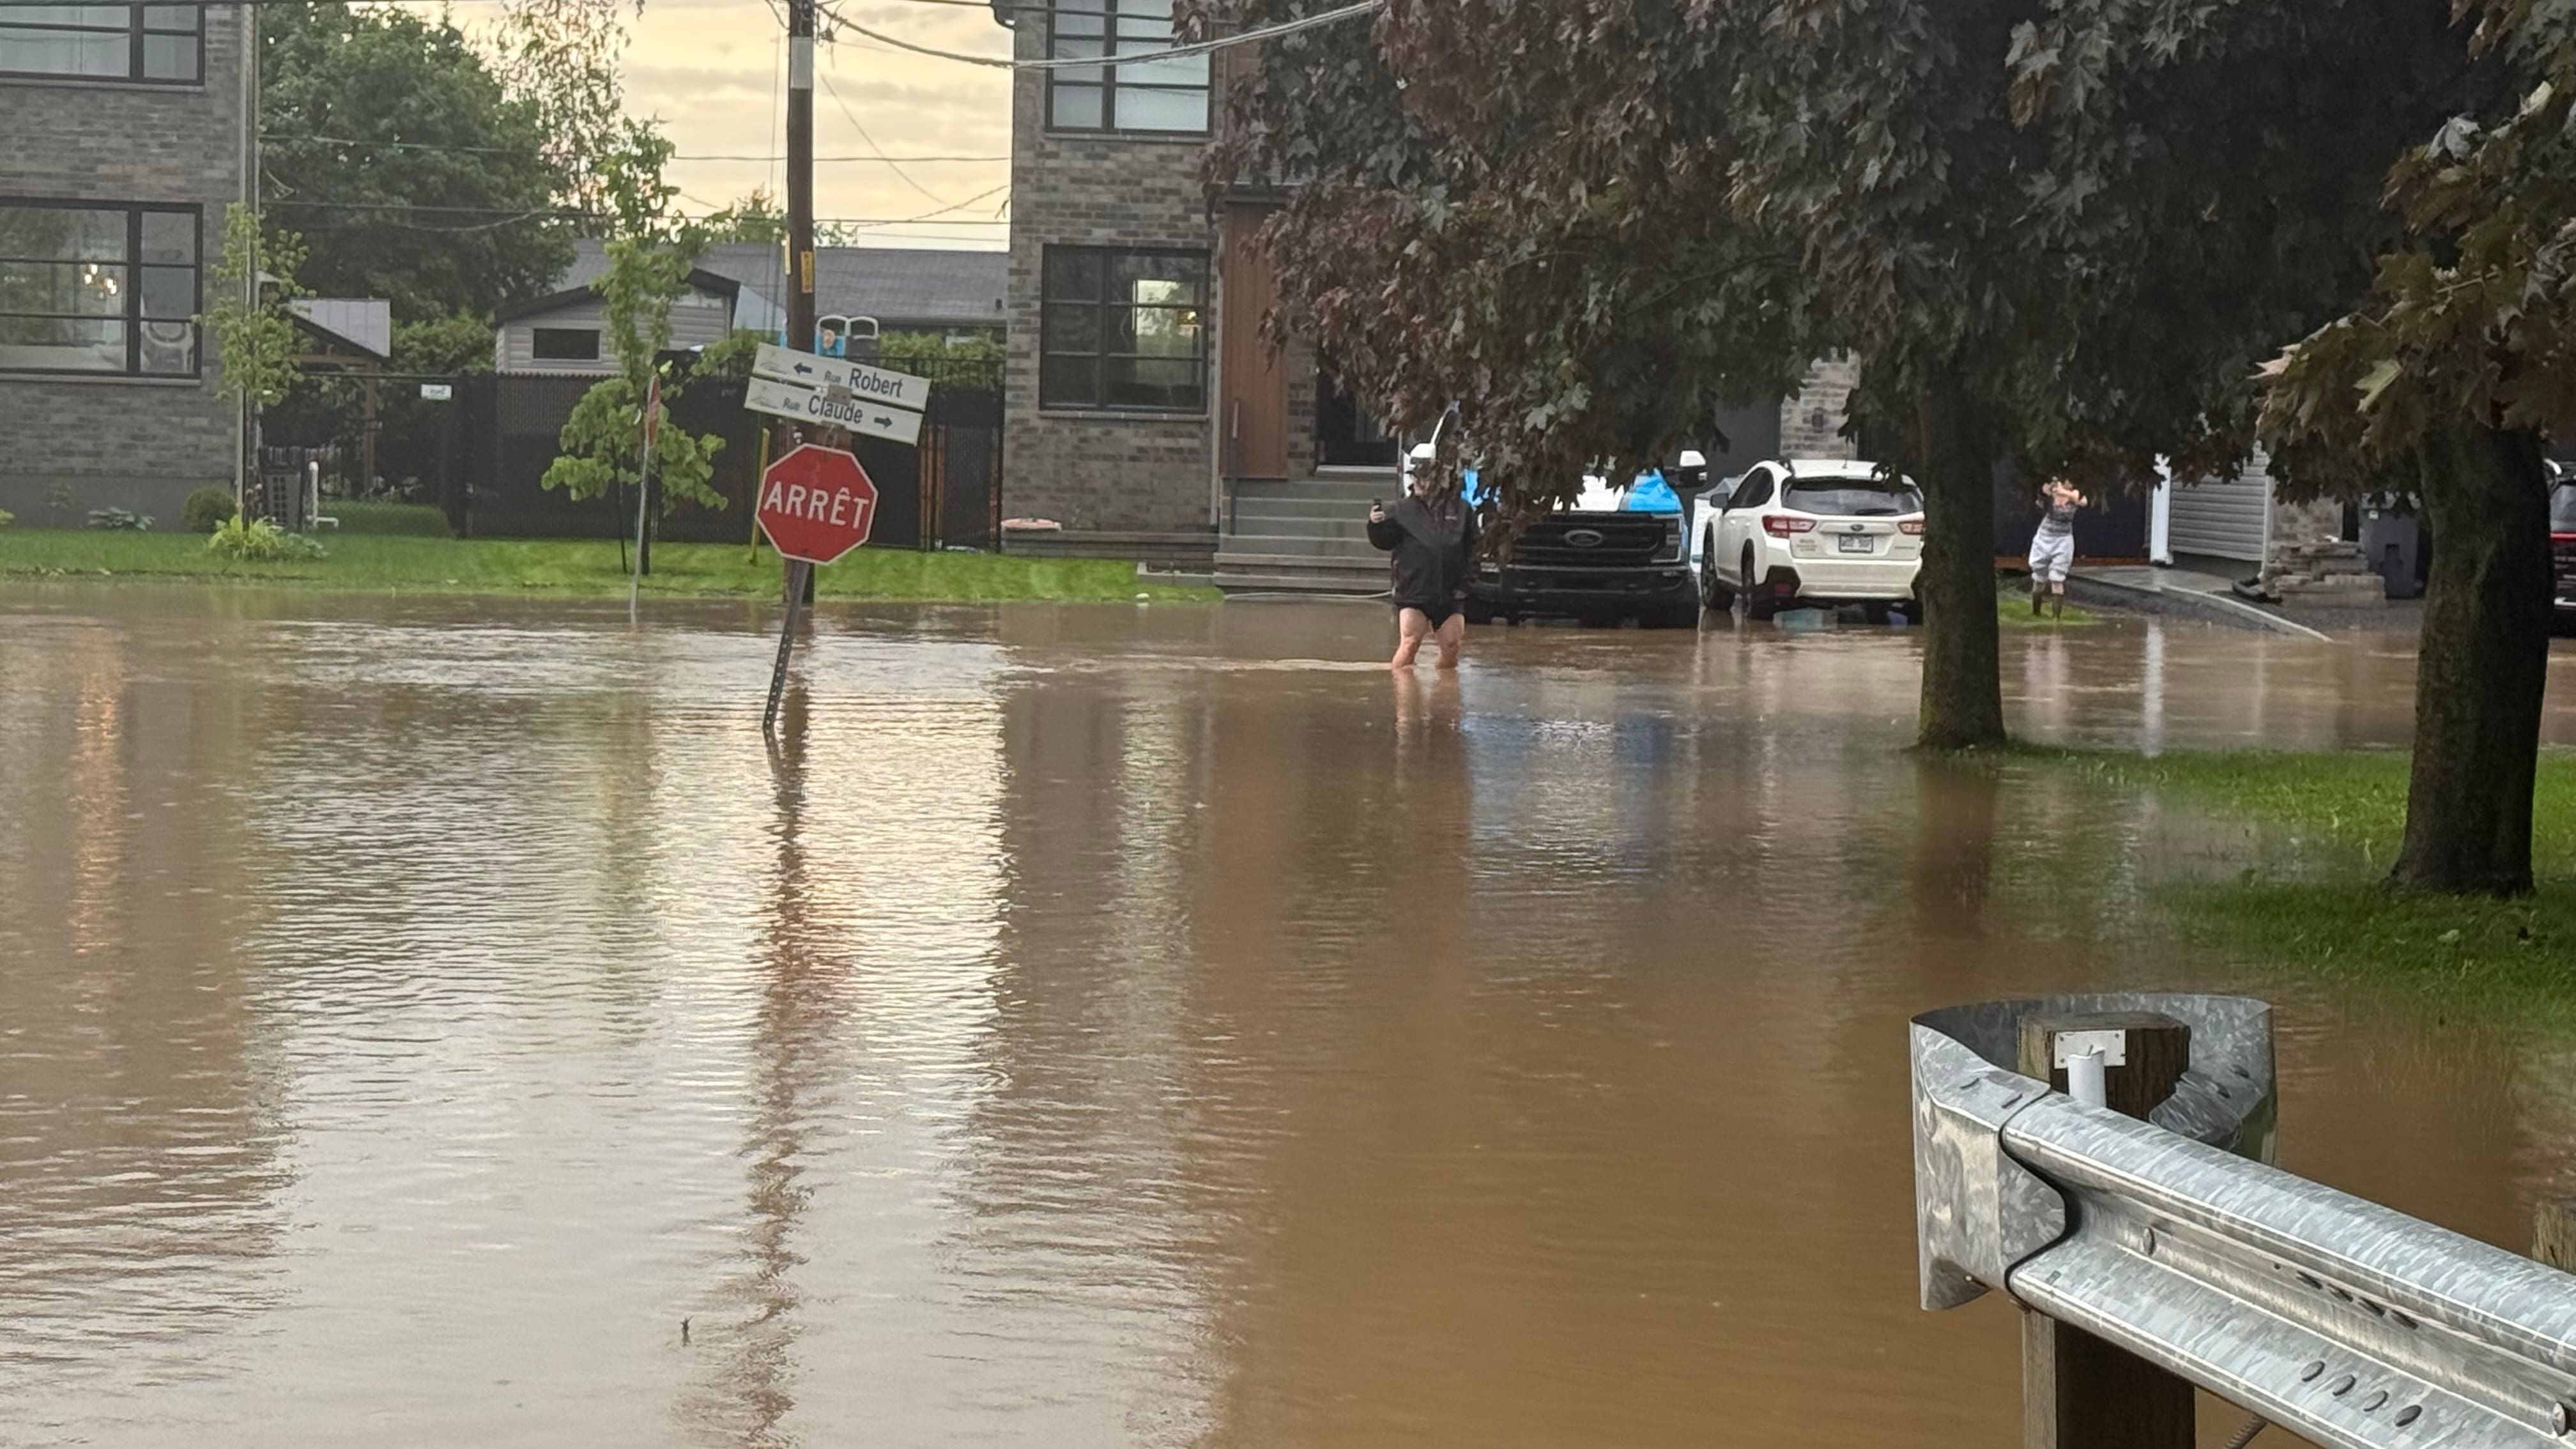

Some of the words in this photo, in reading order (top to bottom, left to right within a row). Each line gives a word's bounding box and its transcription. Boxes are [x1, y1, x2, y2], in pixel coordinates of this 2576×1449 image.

[824, 369, 841, 383] Rue
[849, 367, 903, 398] Robert
[783, 397, 801, 411] Rue
[808, 395, 863, 424] Claude
[763, 481, 870, 530] ARRÊT
